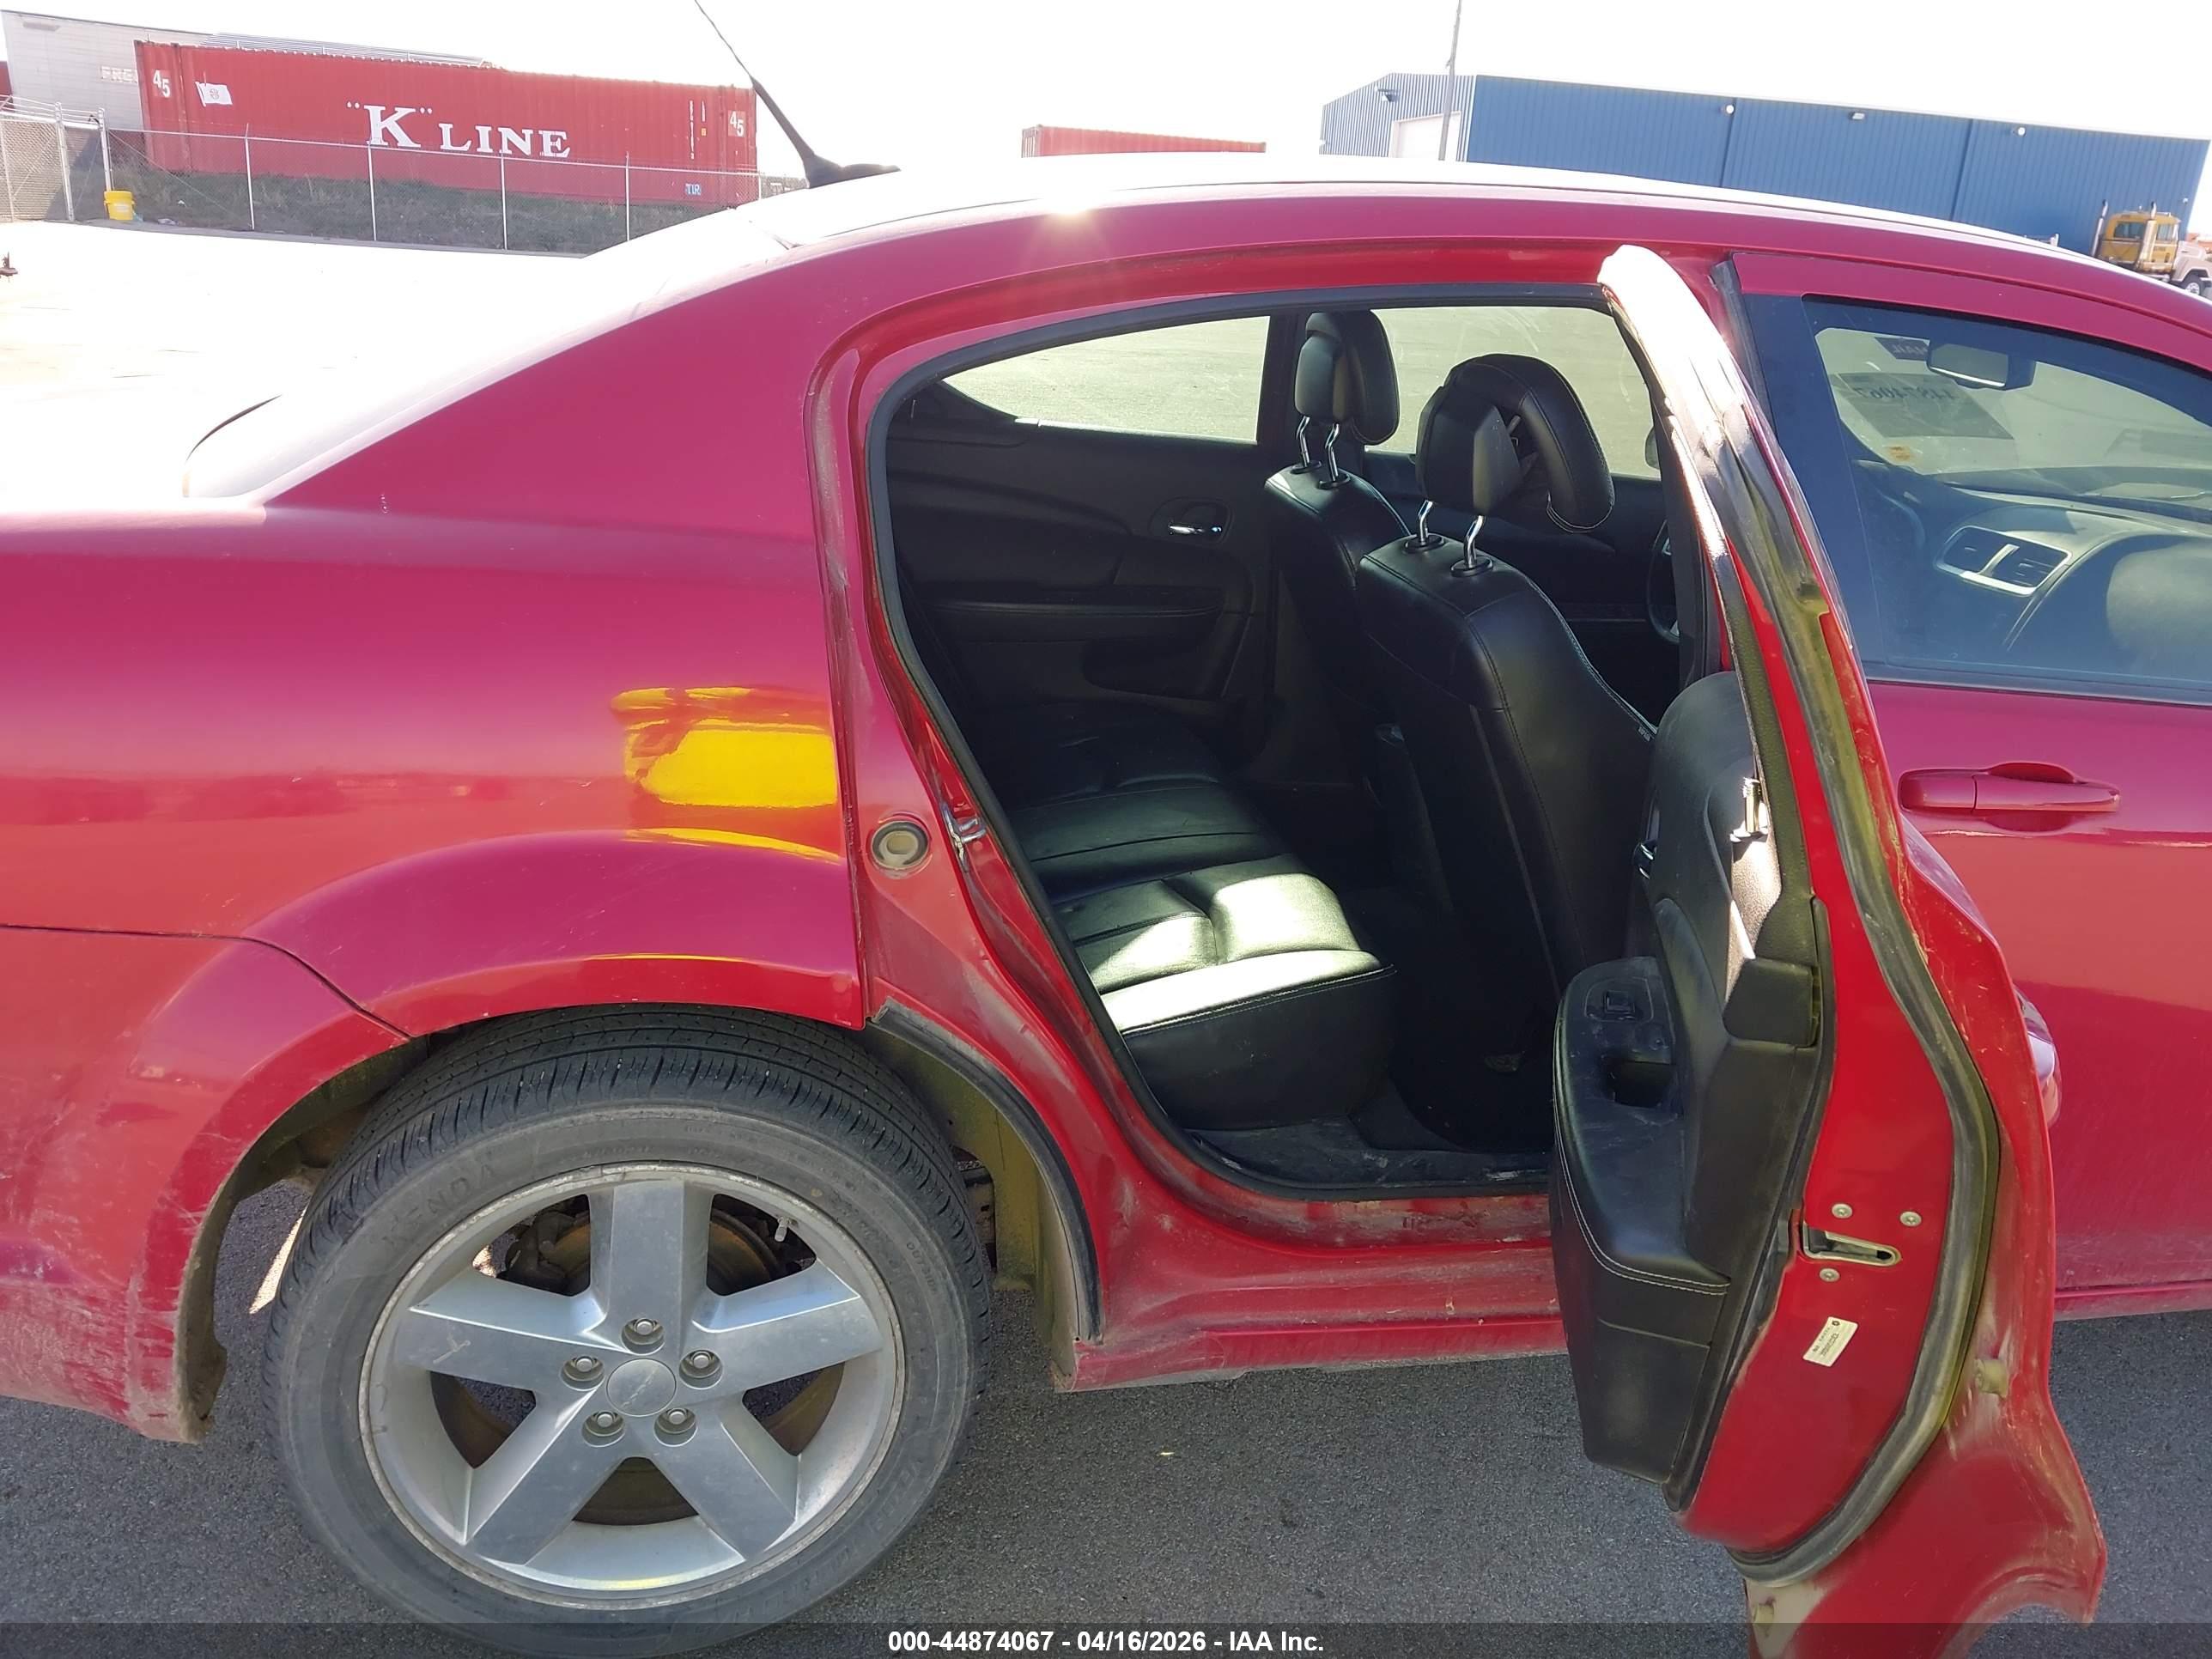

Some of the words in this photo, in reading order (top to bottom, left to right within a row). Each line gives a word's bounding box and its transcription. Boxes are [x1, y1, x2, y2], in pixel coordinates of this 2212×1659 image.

[152, 70, 171, 98] 45
[729, 110, 744, 137] 45
[438, 122, 571, 158] LINE
